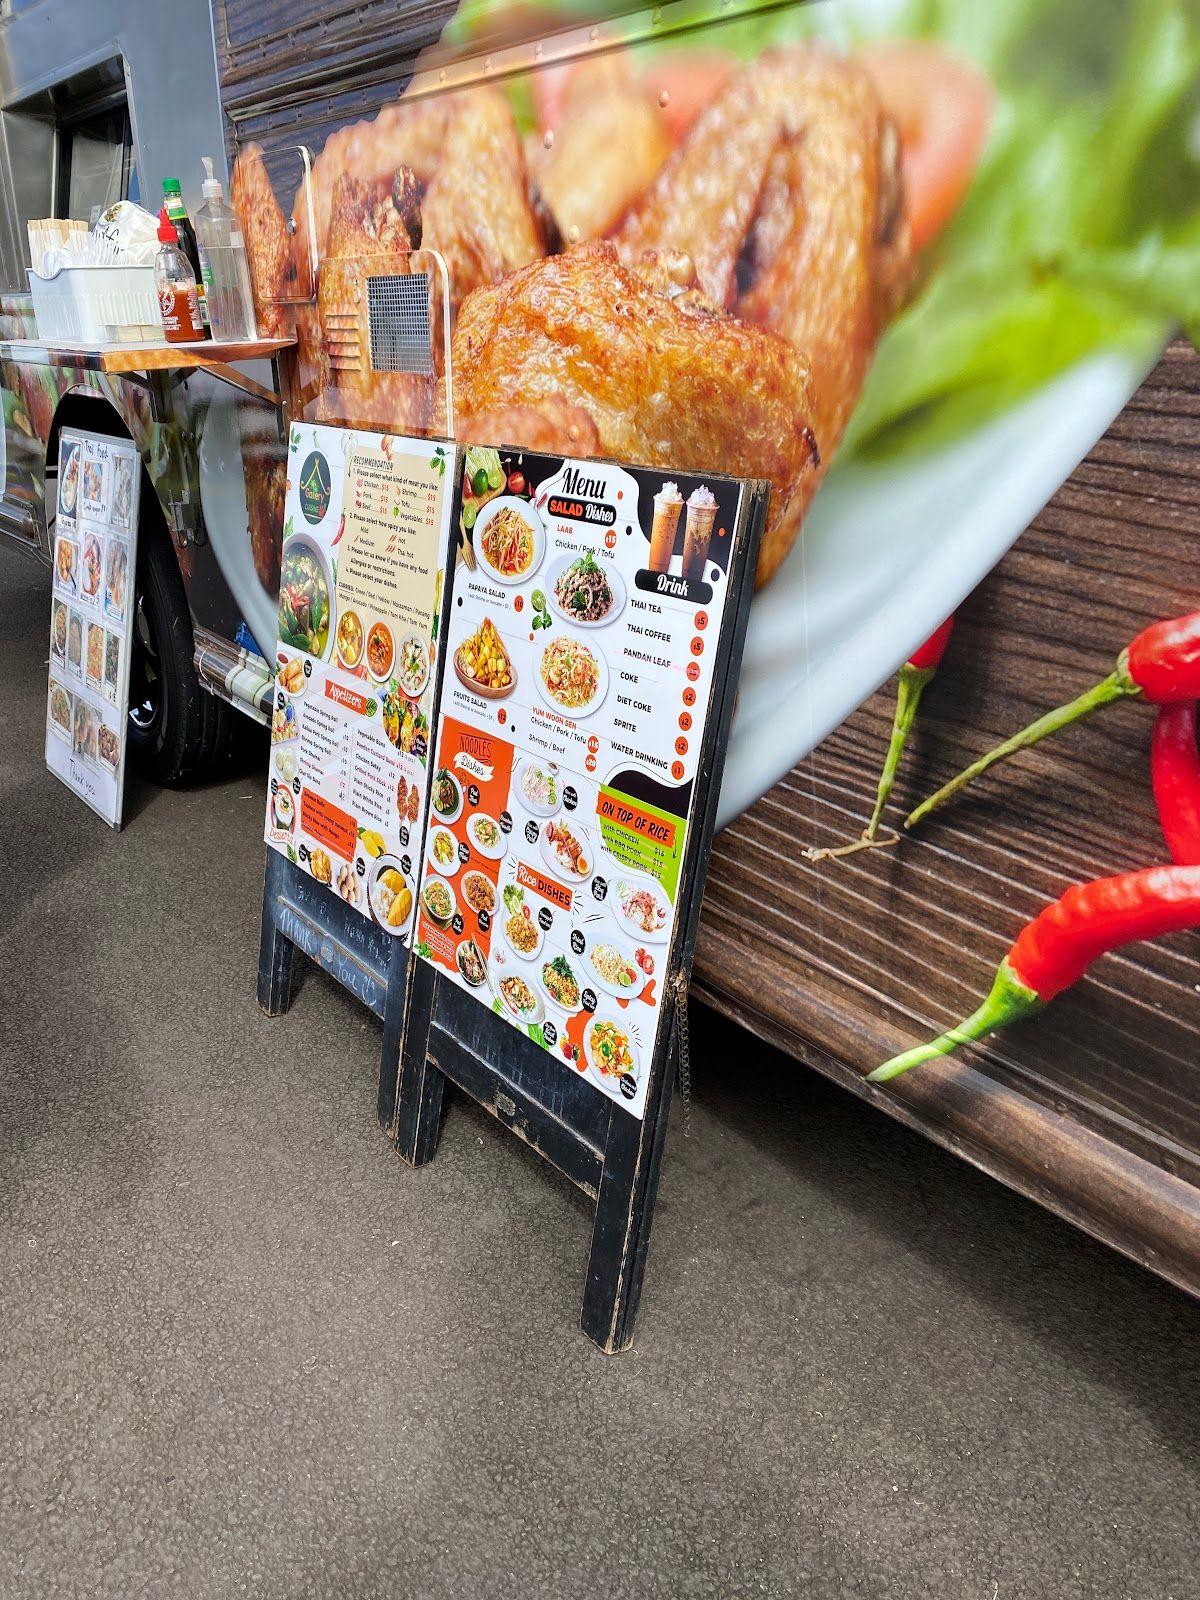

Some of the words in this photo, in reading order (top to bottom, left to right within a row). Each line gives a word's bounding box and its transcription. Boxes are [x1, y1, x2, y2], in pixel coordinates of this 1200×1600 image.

[84, 440, 94, 455] Thai
[97, 443, 108, 459] Food
[353, 455, 393, 471] RECOMMENDATION
[356, 469, 368, 477] Please
[369, 471, 381, 479] select
[382, 474, 392, 482] what
[392, 476, 402, 484] kind
[419, 482, 427, 490] you
[363, 481, 378, 489] Chicken
[561, 467, 606, 500] Menu
[380, 495, 388, 503] $15
[401, 500, 410, 508] Tofu
[426, 505, 434, 513] $15
[402, 488, 417, 498] Shrimp
[427, 493, 435, 501] $15
[379, 506, 387, 514] $15
[400, 512, 422, 523] Vegetables
[425, 517, 433, 526] $15
[549, 499, 583, 517] SALAD
[584, 503, 614, 523] Dishes
[353, 514, 365, 522] Please
[366, 517, 377, 525] select
[387, 522, 398, 531] spicy
[398, 525, 406, 533] you
[557, 524, 573, 534] LAAB
[605, 534, 616, 545] $15
[359, 538, 374, 547] Medium
[397, 548, 405, 556] Thai
[555, 539, 577, 551] Chicken
[582, 544, 595, 554] Pork
[601, 548, 614, 559] Tofu
[350, 557, 366, 568] Allergies
[351, 546, 363, 555] Please
[375, 554, 386, 562] know
[398, 560, 408, 569] have
[409, 564, 417, 572] any
[418, 566, 428, 575] food
[349, 568, 361, 576] Please
[362, 572, 373, 580] select
[373, 576, 382, 585] your
[655, 573, 689, 597] Drink
[377, 595, 389, 604] Yellow
[468, 583, 487, 594] PAPAYA
[488, 588, 505, 599] SALAD
[514, 599, 523, 608] $10
[352, 597, 366, 607] Avocado
[369, 603, 387, 616] Pineapple
[418, 621, 427, 629] Yum
[630, 599, 647, 610] THAI
[648, 603, 662, 614] TEA
[697, 616, 705, 626] $5
[626, 623, 643, 634] THAI
[644, 628, 671, 642] COFFEE
[693, 641, 700, 651] $5
[623, 648, 651, 662] PANDAN
[652, 656, 671, 668] LEAF
[329, 683, 361, 709] Appetizers
[620, 671, 638, 683] COKE
[685, 692, 693, 701] $2
[453, 690, 470, 702] FRUITS
[470, 697, 487, 709] SALAD
[498, 711, 506, 721] $12
[616, 695, 631, 706] DIET
[633, 700, 651, 713] COKE
[681, 717, 688, 726] $2
[530, 716, 551, 730] Chicken
[556, 726, 569, 737] Pork
[573, 733, 586, 744] Tofu
[532, 706, 544, 717] YUM
[545, 712, 563, 724] WOON
[588, 739, 599, 749] $15
[613, 718, 636, 732] SPRITE
[677, 741, 685, 751] $2
[459, 735, 491, 759] NOODLES
[528, 733, 548, 748] Shrimp
[552, 743, 565, 754] Beef
[460, 754, 484, 776] Dishes
[610, 741, 633, 756] WATER
[634, 750, 668, 770] DRINKING
[674, 766, 681, 775] $1
[70, 759, 84, 785] Thank
[601, 800, 614, 817] ON
[616, 807, 633, 826] TOP
[634, 815, 644, 831] OF
[647, 821, 669, 842] RICE
[603, 822, 614, 833] with
[615, 828, 639, 845] CHICKEN
[600, 844, 611, 855] with
[612, 850, 633, 865] CRISPY
[634, 861, 647, 872] PORK
[650, 869, 661, 879] $15
[601, 833, 613, 844] with
[614, 839, 625, 850] BBQ
[626, 845, 641, 858] PORK
[652, 858, 663, 868] $15
[518, 864, 537, 888] Rice
[537, 879, 570, 906] DISHES
